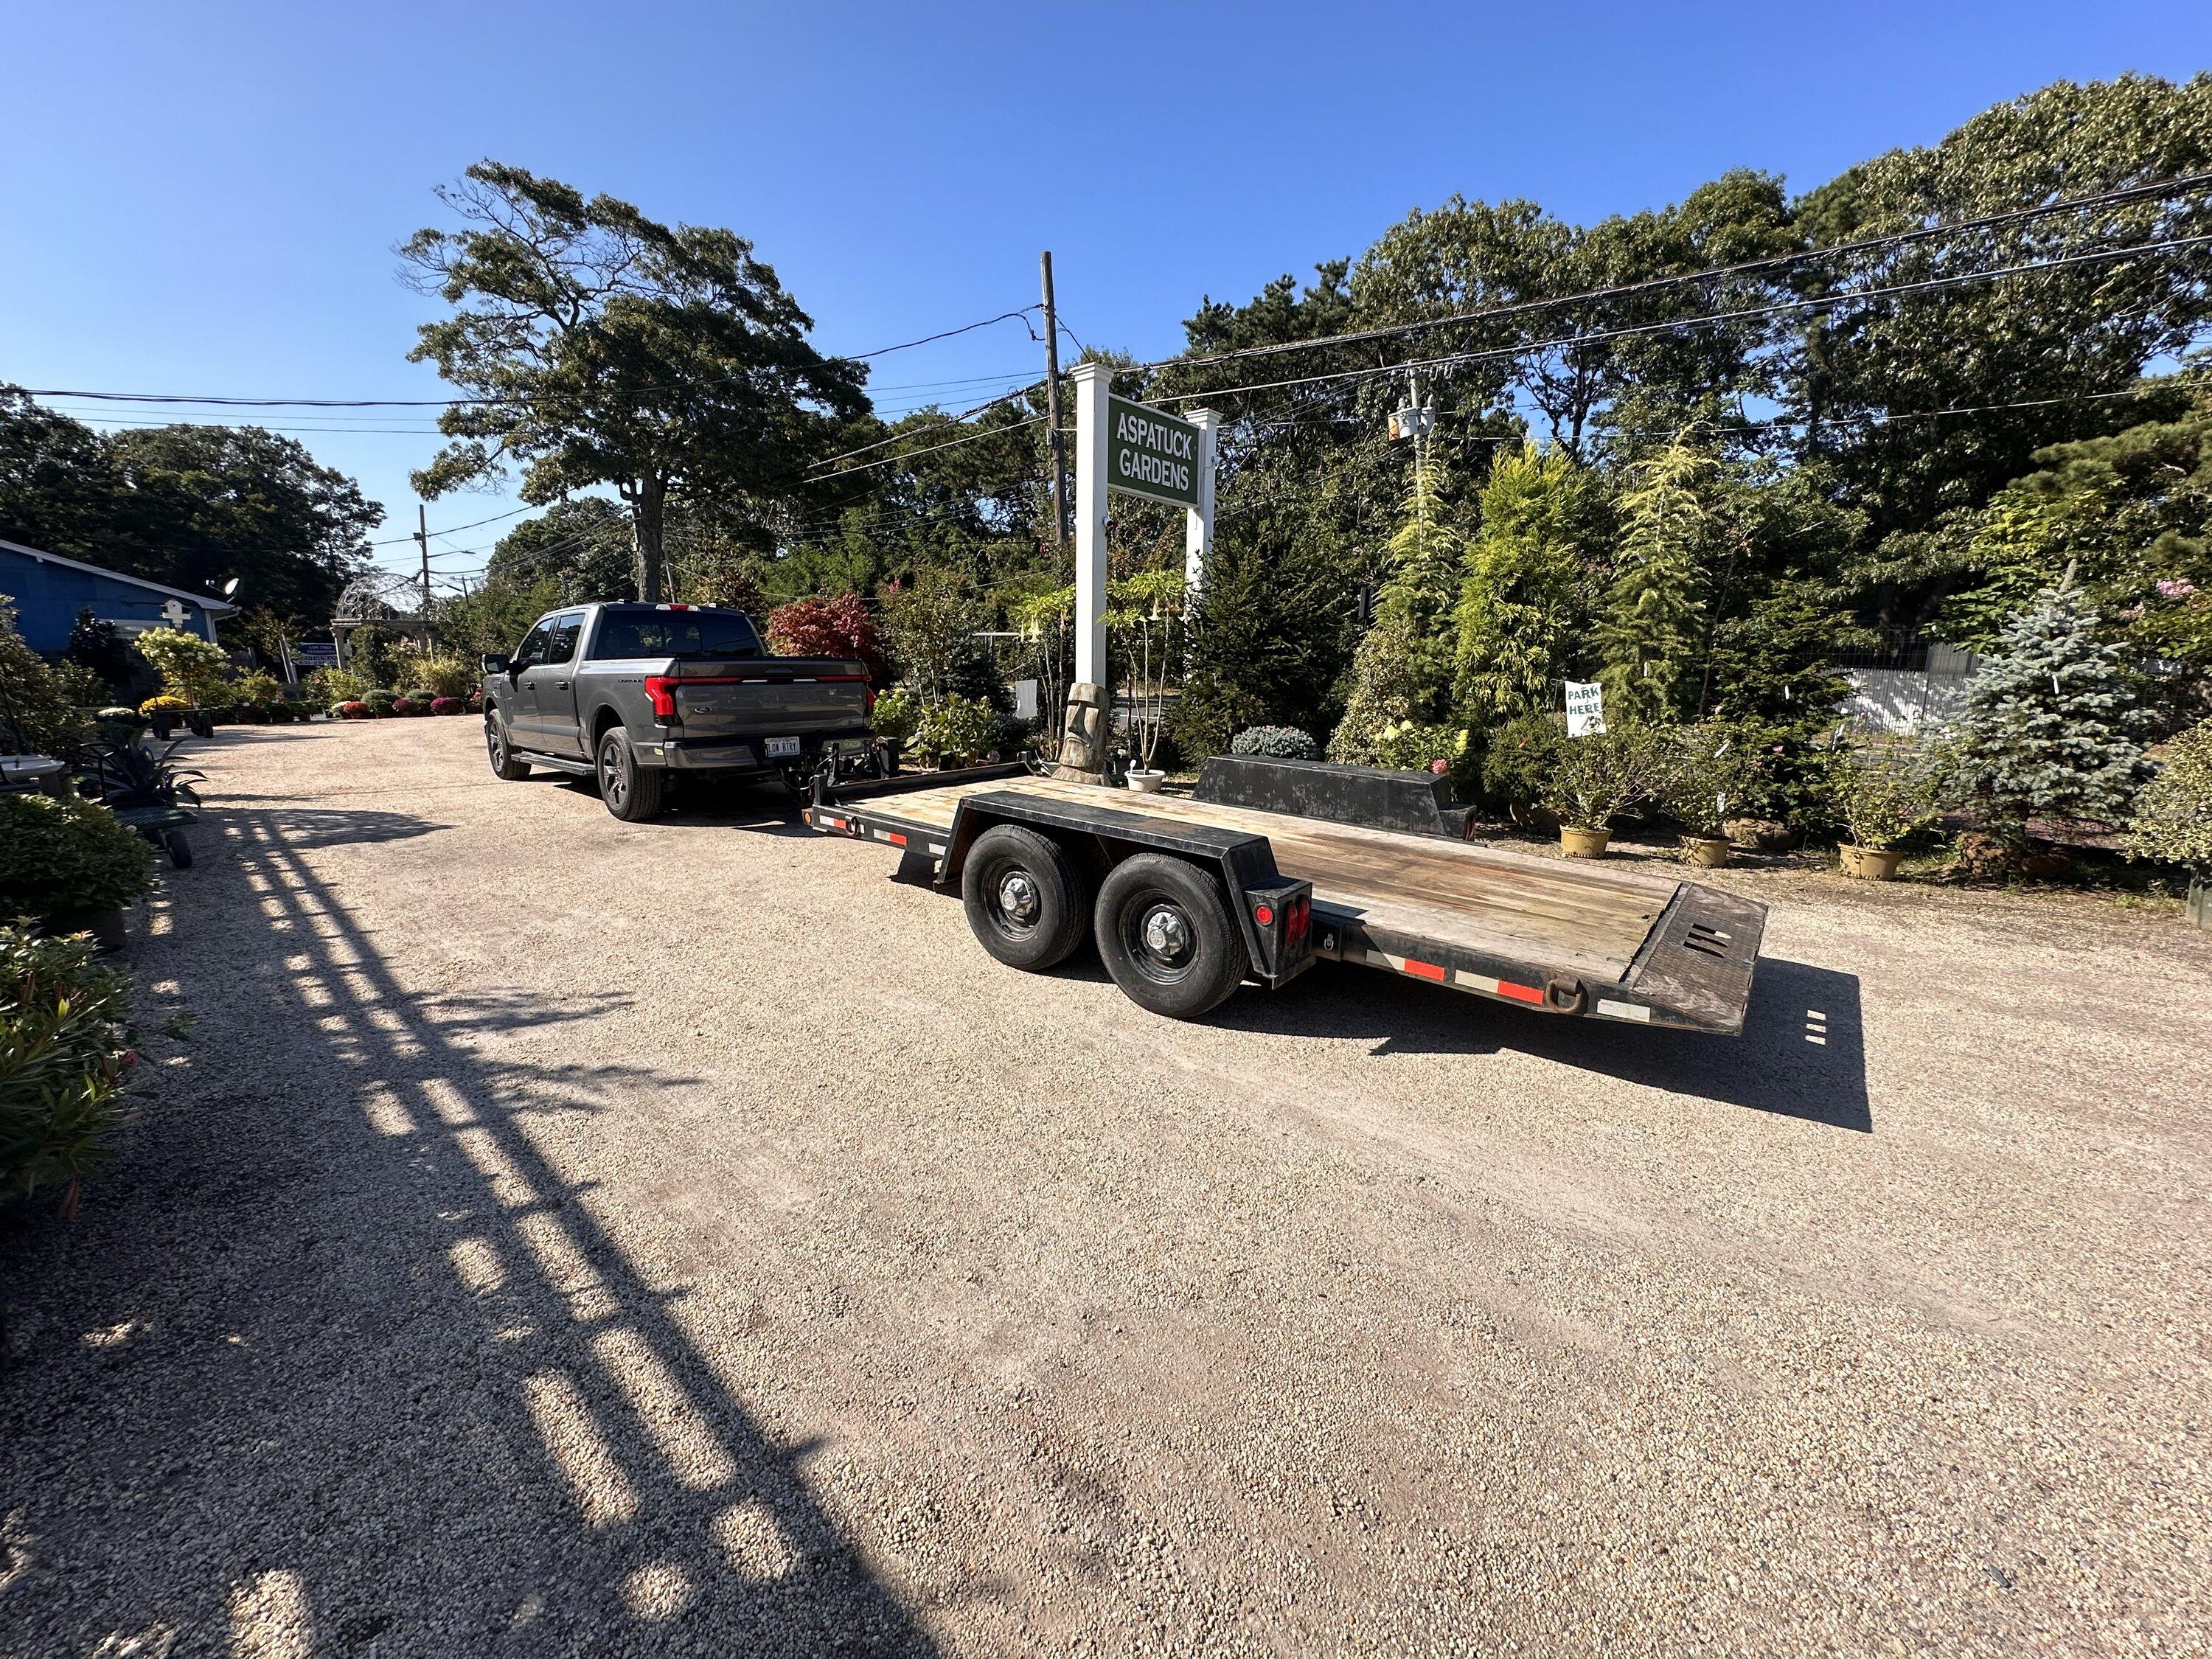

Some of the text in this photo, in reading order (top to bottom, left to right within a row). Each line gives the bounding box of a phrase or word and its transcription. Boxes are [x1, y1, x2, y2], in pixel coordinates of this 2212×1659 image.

[1116, 412, 1192, 461] ASPATUCK
[1119, 448, 1189, 491] GARDENS
[1568, 686, 1599, 700] PARK
[1569, 703, 1599, 714] HERE
[782, 742, 796, 751] BTRY
